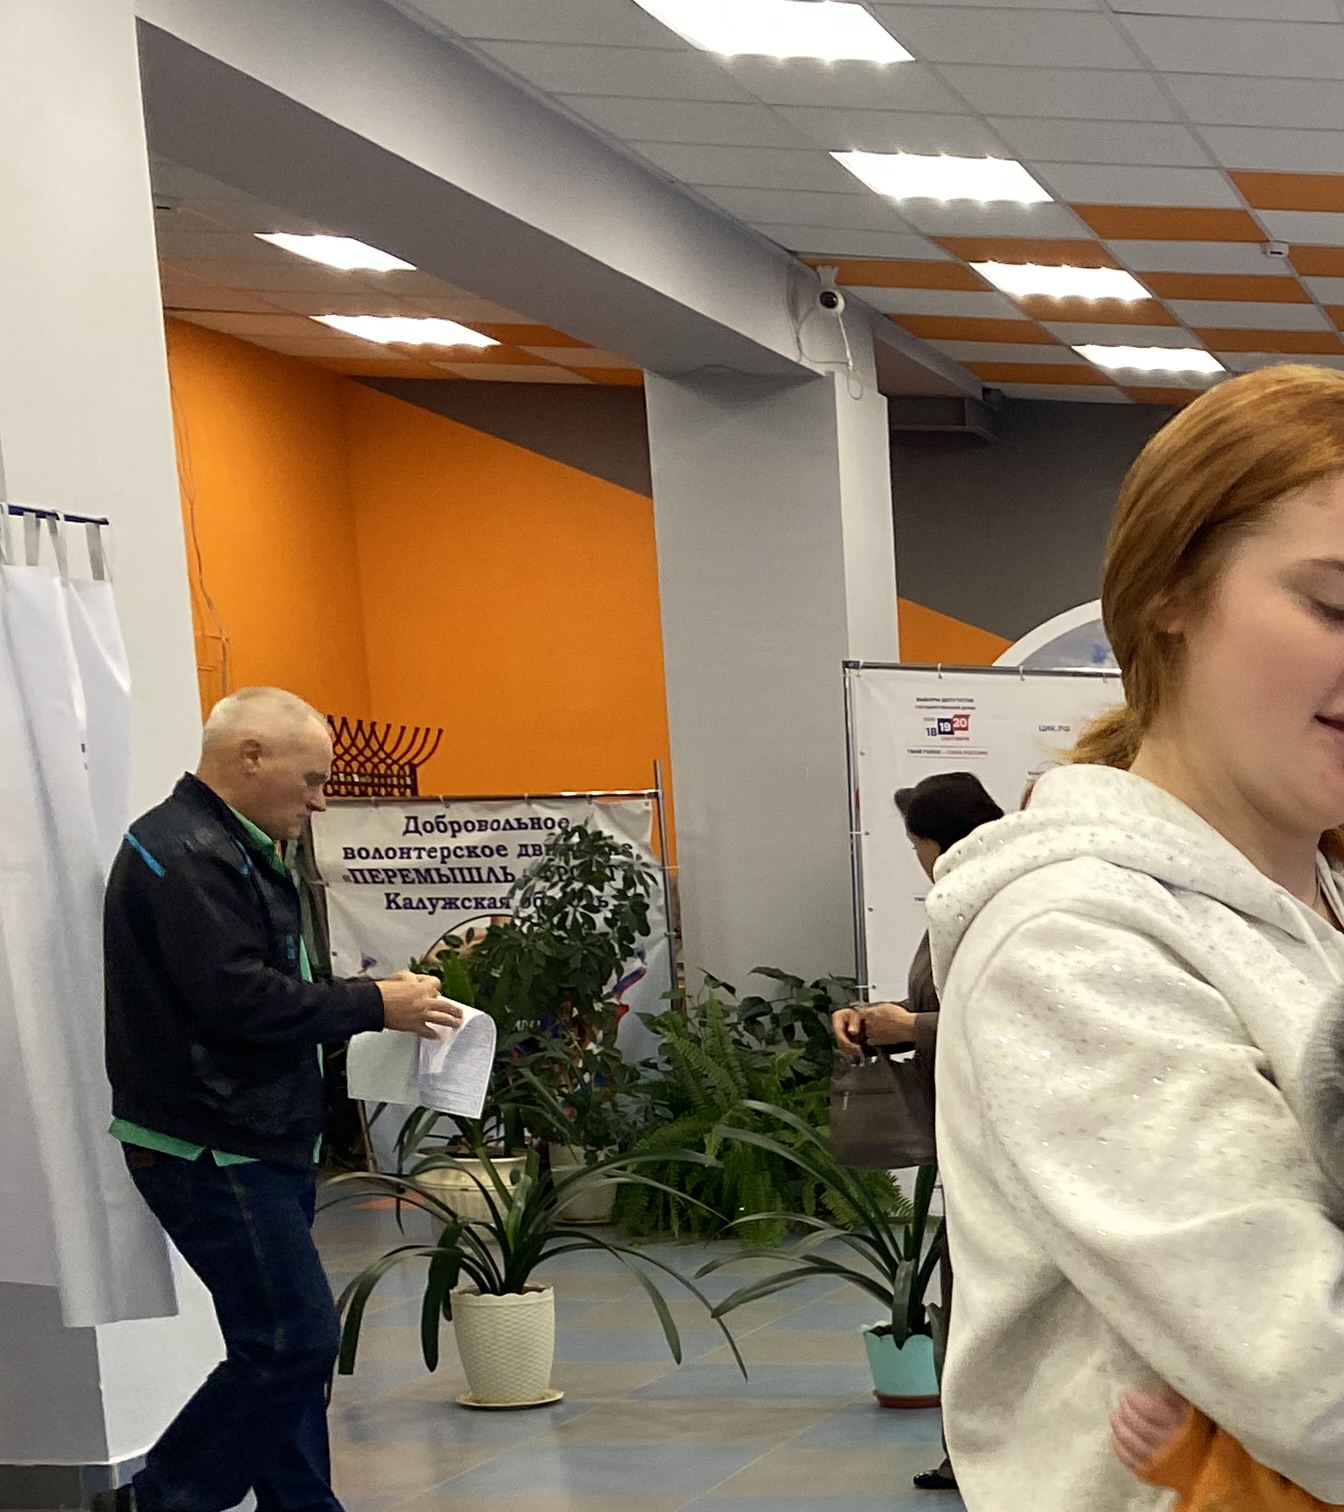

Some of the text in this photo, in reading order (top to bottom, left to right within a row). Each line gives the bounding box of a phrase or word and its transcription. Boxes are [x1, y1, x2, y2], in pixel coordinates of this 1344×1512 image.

[926, 717, 967, 737] 18 19 20
[402, 815, 570, 838] Добровольное
[343, 842, 509, 864] волонтерское
[385, 893, 511, 914] Калужская
